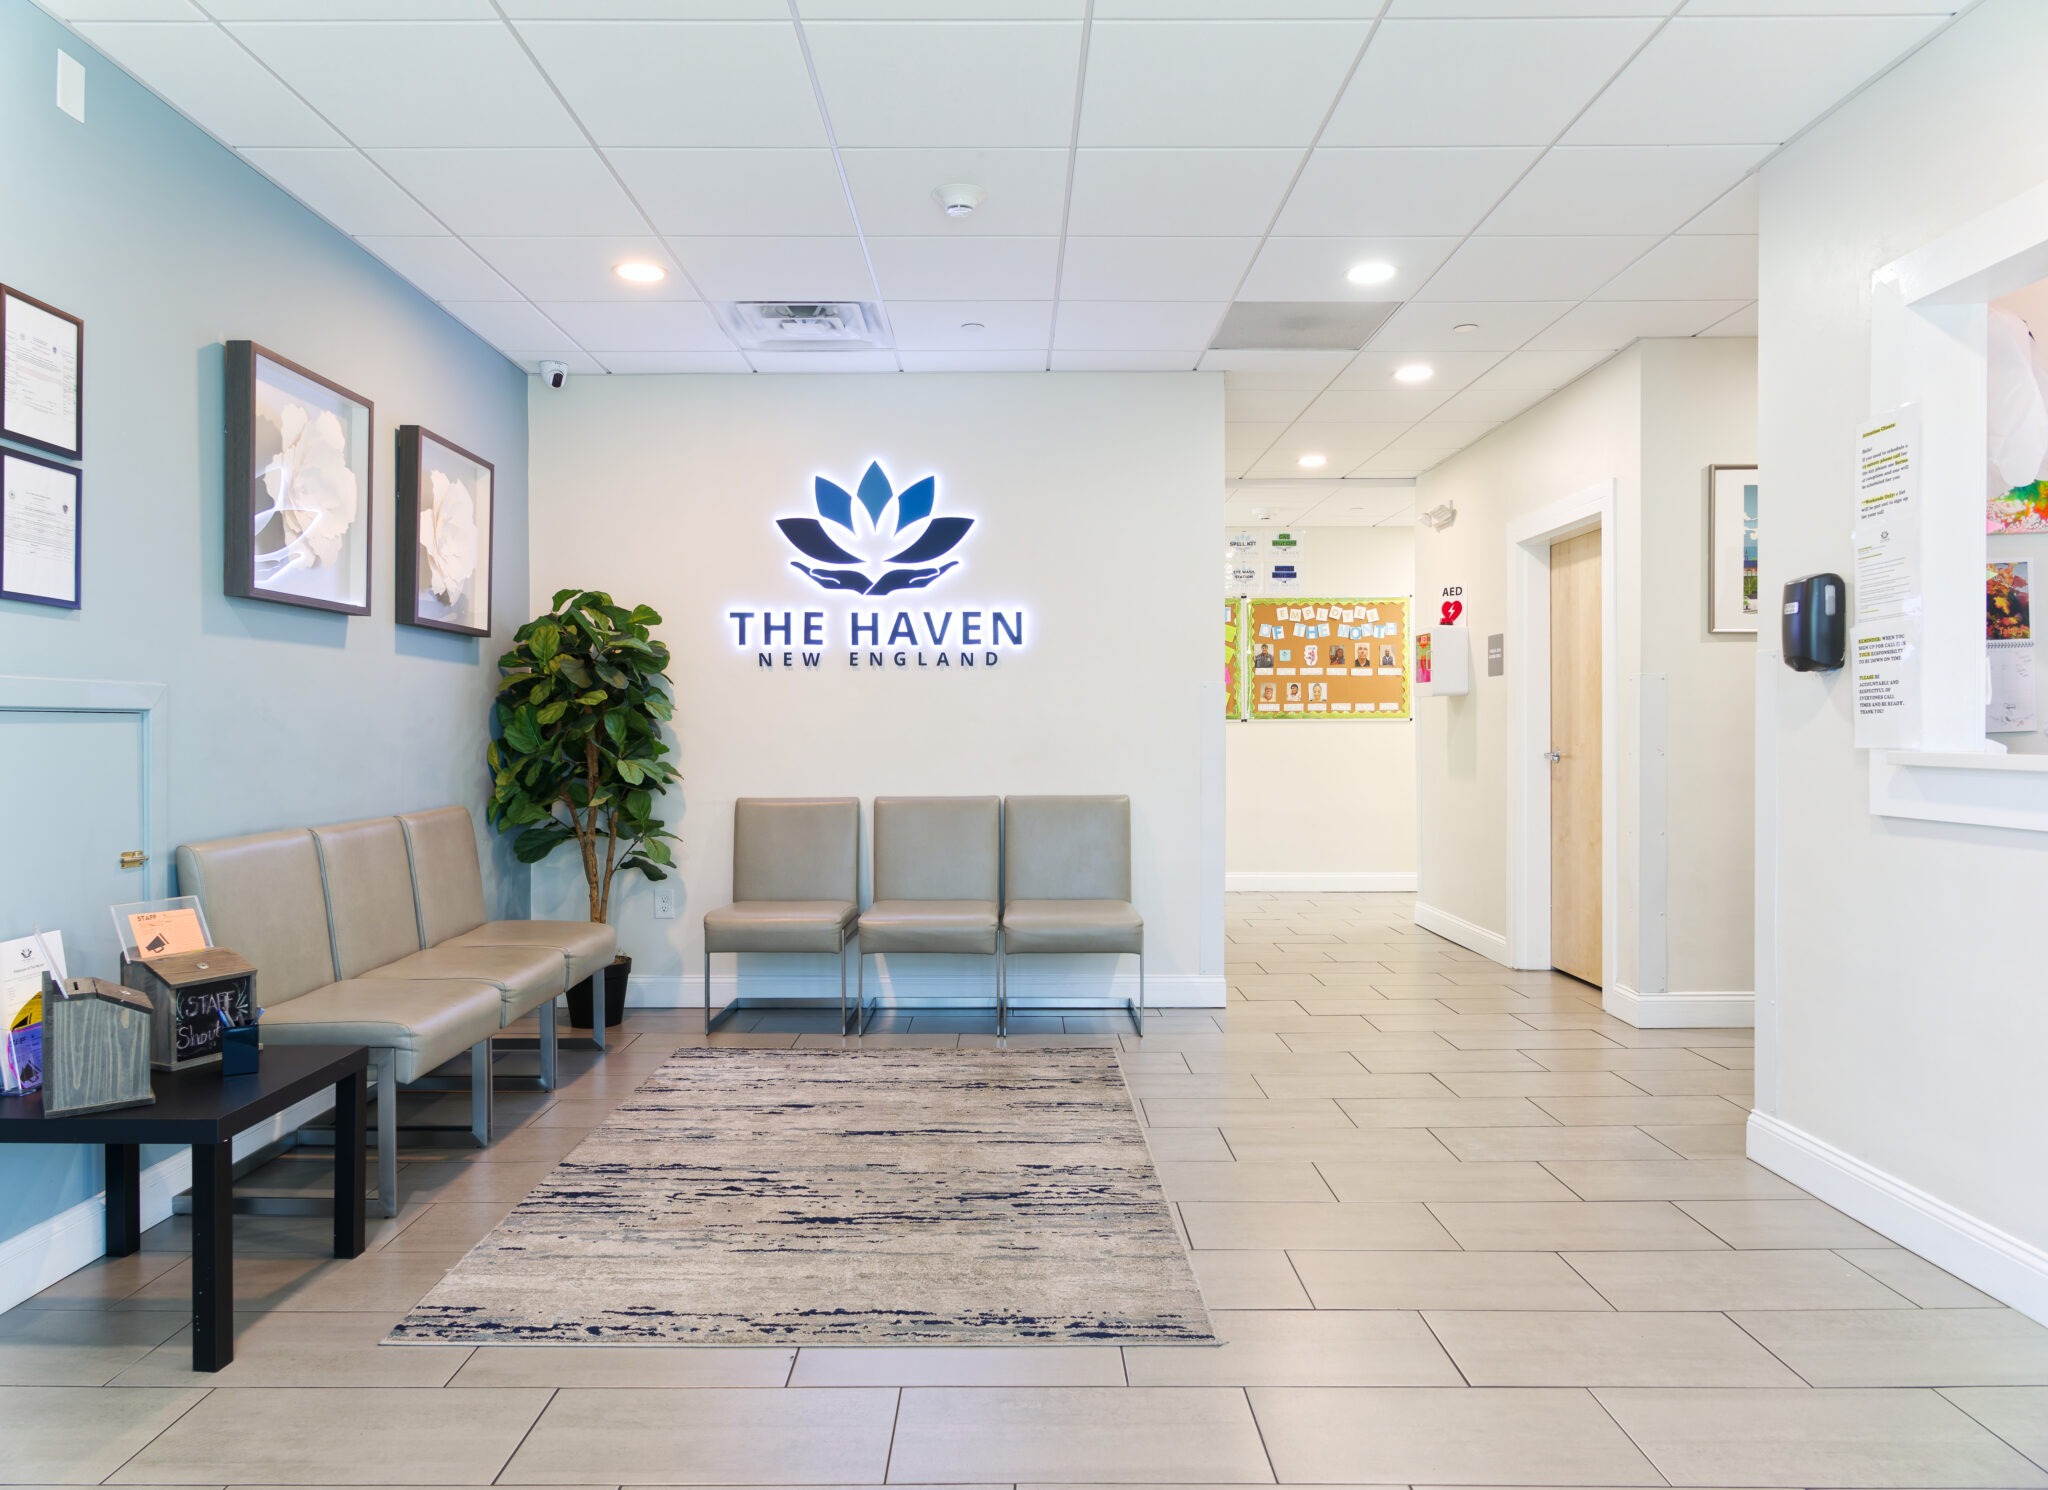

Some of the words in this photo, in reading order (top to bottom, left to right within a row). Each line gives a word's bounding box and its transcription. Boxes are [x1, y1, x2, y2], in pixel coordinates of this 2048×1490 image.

[1442, 586, 1463, 597] AED
[1278, 607, 1377, 621] EMPLOYEE
[729, 611, 824, 646] THE
[851, 611, 1023, 646] HAVEN
[1260, 624, 1284, 639] OF
[1294, 623, 1329, 639] THE
[1338, 623, 1397, 639] MONTH
[758, 652, 821, 667] NEW
[849, 652, 998, 667] ENGLAND
[185, 990, 235, 1017] STAFF
[176, 1020, 221, 1050] Shout
